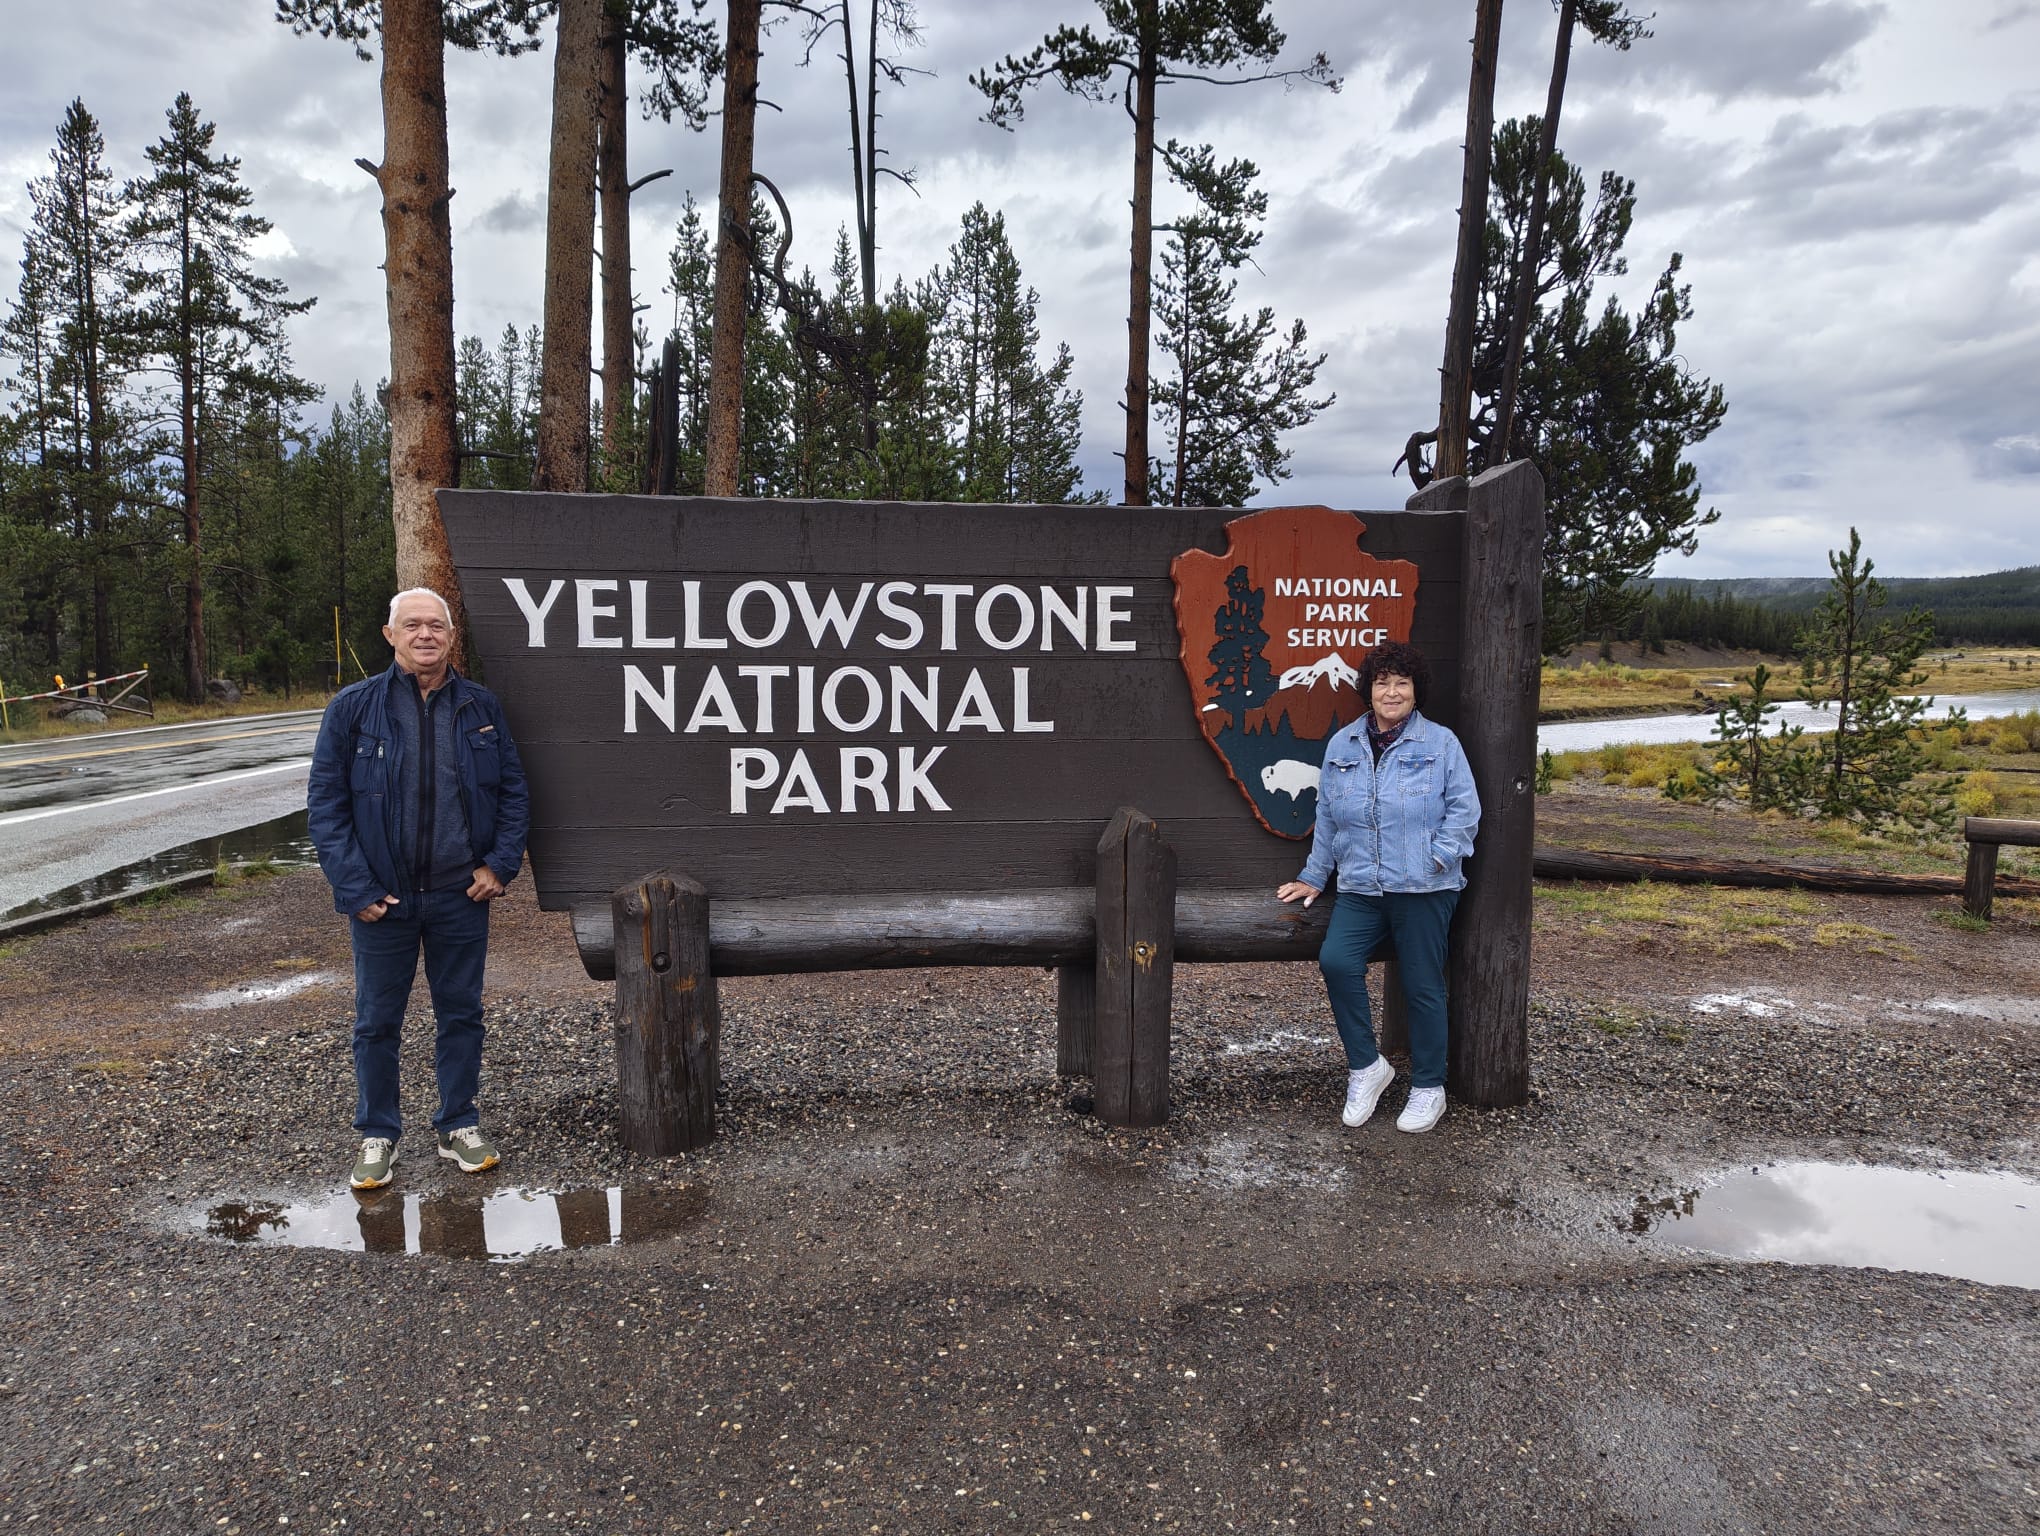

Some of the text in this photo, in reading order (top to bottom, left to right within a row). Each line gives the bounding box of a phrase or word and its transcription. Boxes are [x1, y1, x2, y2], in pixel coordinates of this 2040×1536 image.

[1275, 578, 1403, 597] NATIONAL
[501, 577, 1138, 652] YELLOWSTONE
[1305, 603, 1370, 622] PARK
[1287, 628, 1388, 647] SERVICE
[621, 664, 1055, 734] NATIONAL
[728, 746, 953, 815] PARK
